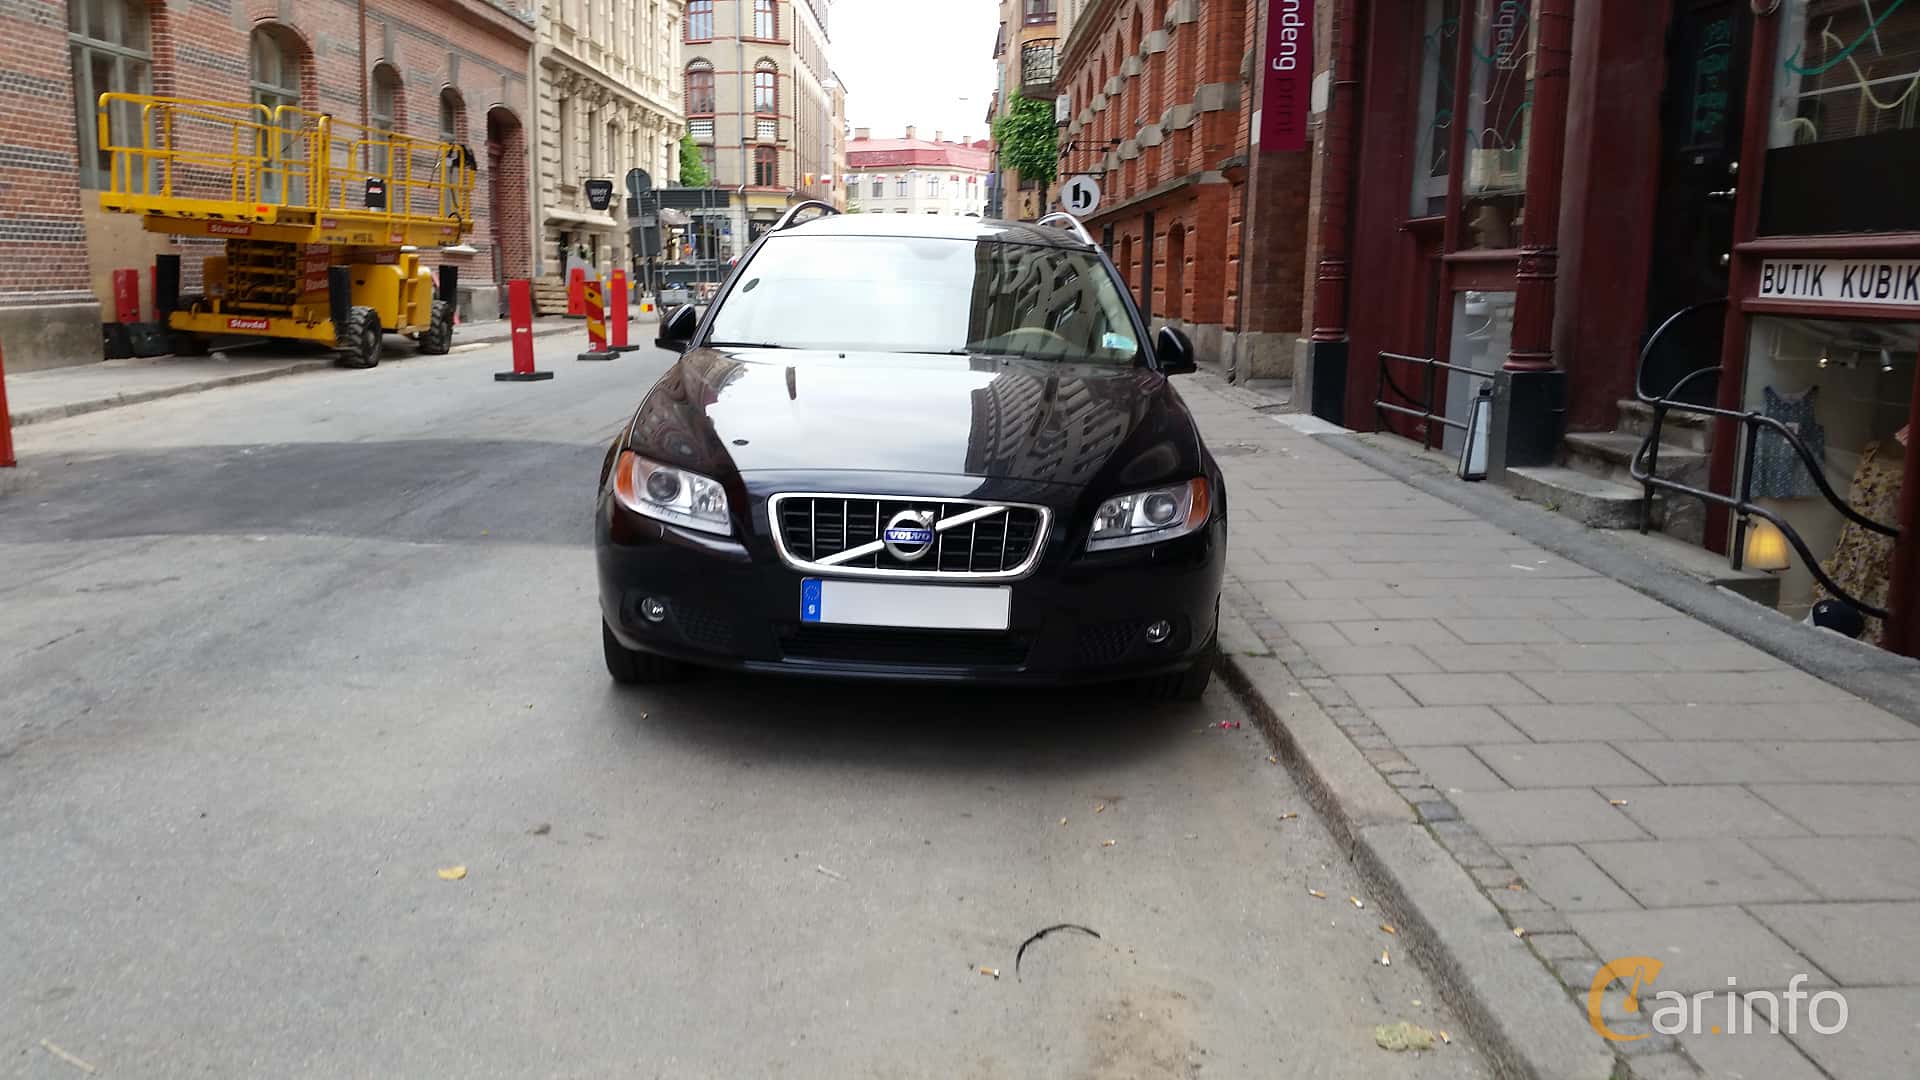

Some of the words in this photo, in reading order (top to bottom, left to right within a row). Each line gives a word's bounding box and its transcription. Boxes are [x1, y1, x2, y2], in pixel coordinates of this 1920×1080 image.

[1762, 263, 1827, 297] BUTIK
[1840, 264, 1920, 301] KUBIK
[888, 531, 931, 541] VOLVO
